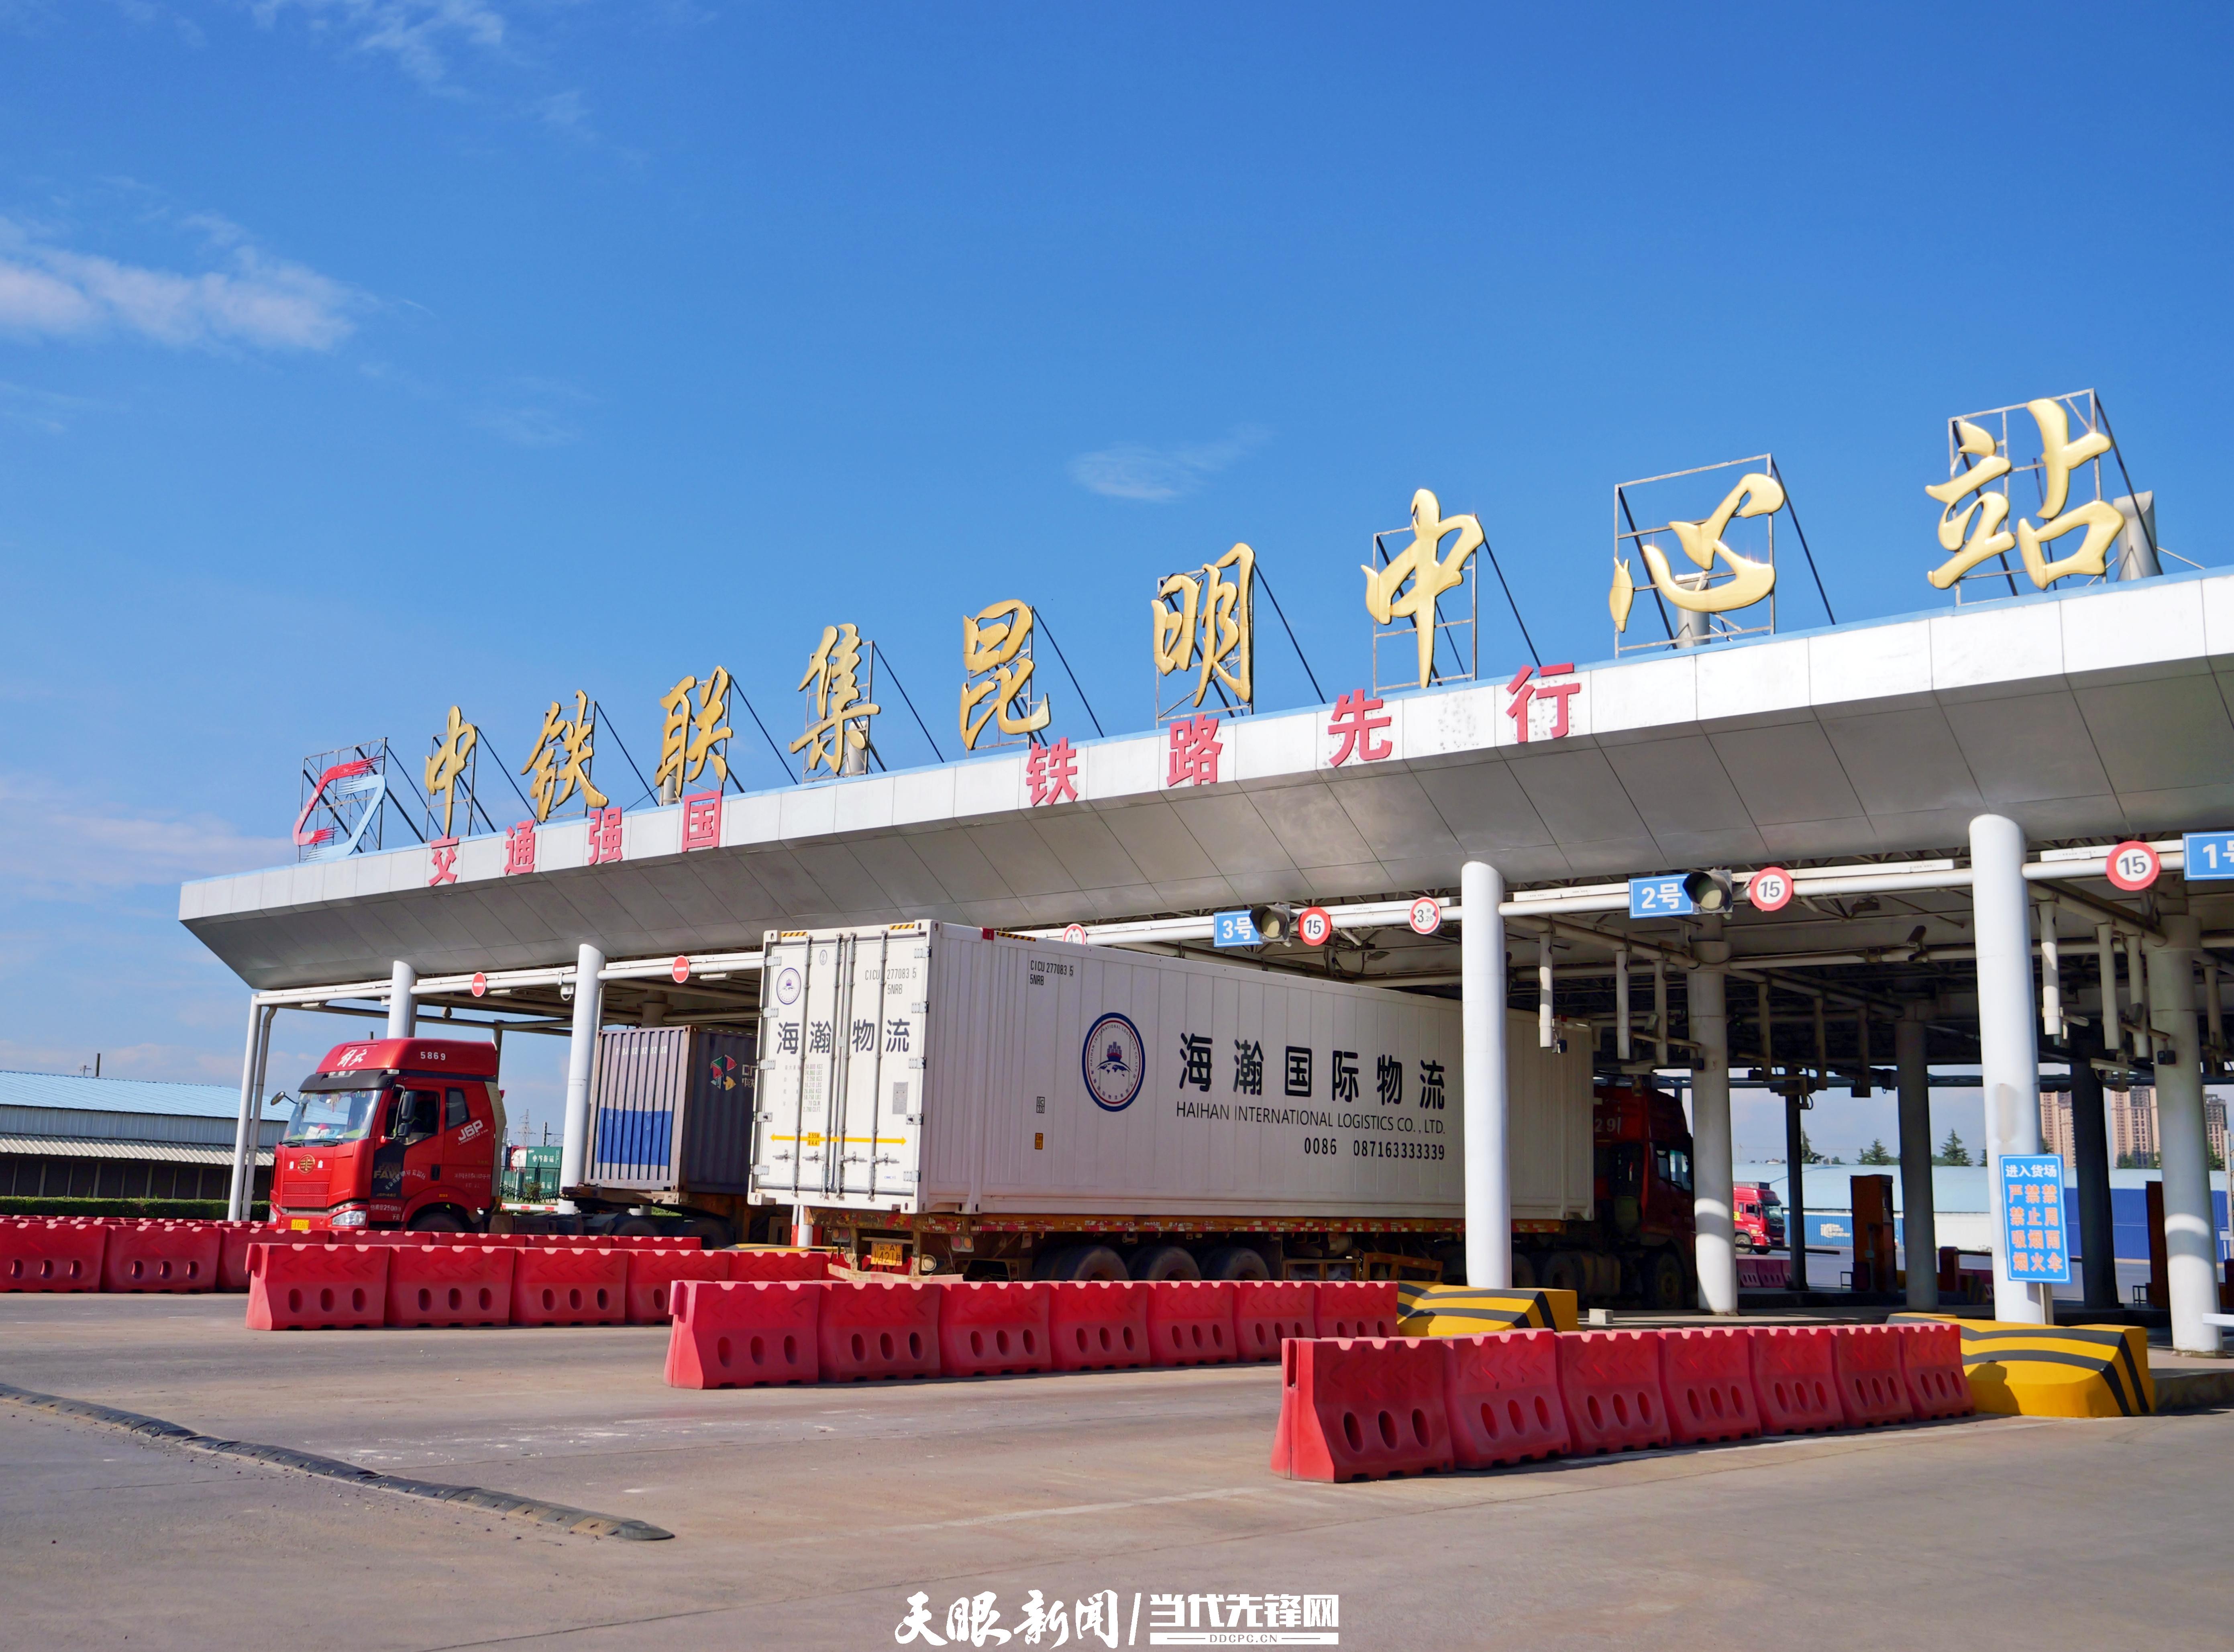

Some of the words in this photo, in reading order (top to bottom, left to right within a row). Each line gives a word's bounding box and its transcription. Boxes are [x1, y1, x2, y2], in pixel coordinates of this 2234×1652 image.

[428, 790, 723, 887] 交通强国
[1026, 663, 1580, 806] 铁路先行
[2119, 855, 2146, 875] 15
[1641, 883, 1682, 910] 2号
[1759, 880, 1780, 898] 15
[1223, 918, 1253, 940] 3号
[1306, 920, 1321, 935] 15
[865, 969, 880, 980] CICU
[887, 968, 909, 979] 277083
[912, 967, 917, 979] 5
[1031, 960, 1045, 972] CICU
[1046, 963, 1067, 975] 277083
[1070, 966, 1073, 976] 5
[887, 984, 903, 995] 5NRB
[1030, 974, 1044, 986] 5NRB
[777, 1019, 910, 1055] 海瀚物流
[420, 1051, 446, 1061] 5869
[1179, 1032, 1445, 1109] 海瀚国际物流
[1177, 1101, 1229, 1120] HAIHAN
[1235, 1105, 1333, 1127] INTERNATIONAL
[1338, 1113, 1394, 1131] LOGISTICS
[1425, 1119, 1445, 1134] LTD.
[458, 1120, 483, 1141] J6P
[1305, 1137, 1337, 1155] 0086
[1353, 1140, 1445, 1160] 087163333339
[2005, 1165, 2057, 1177] 进入货场
